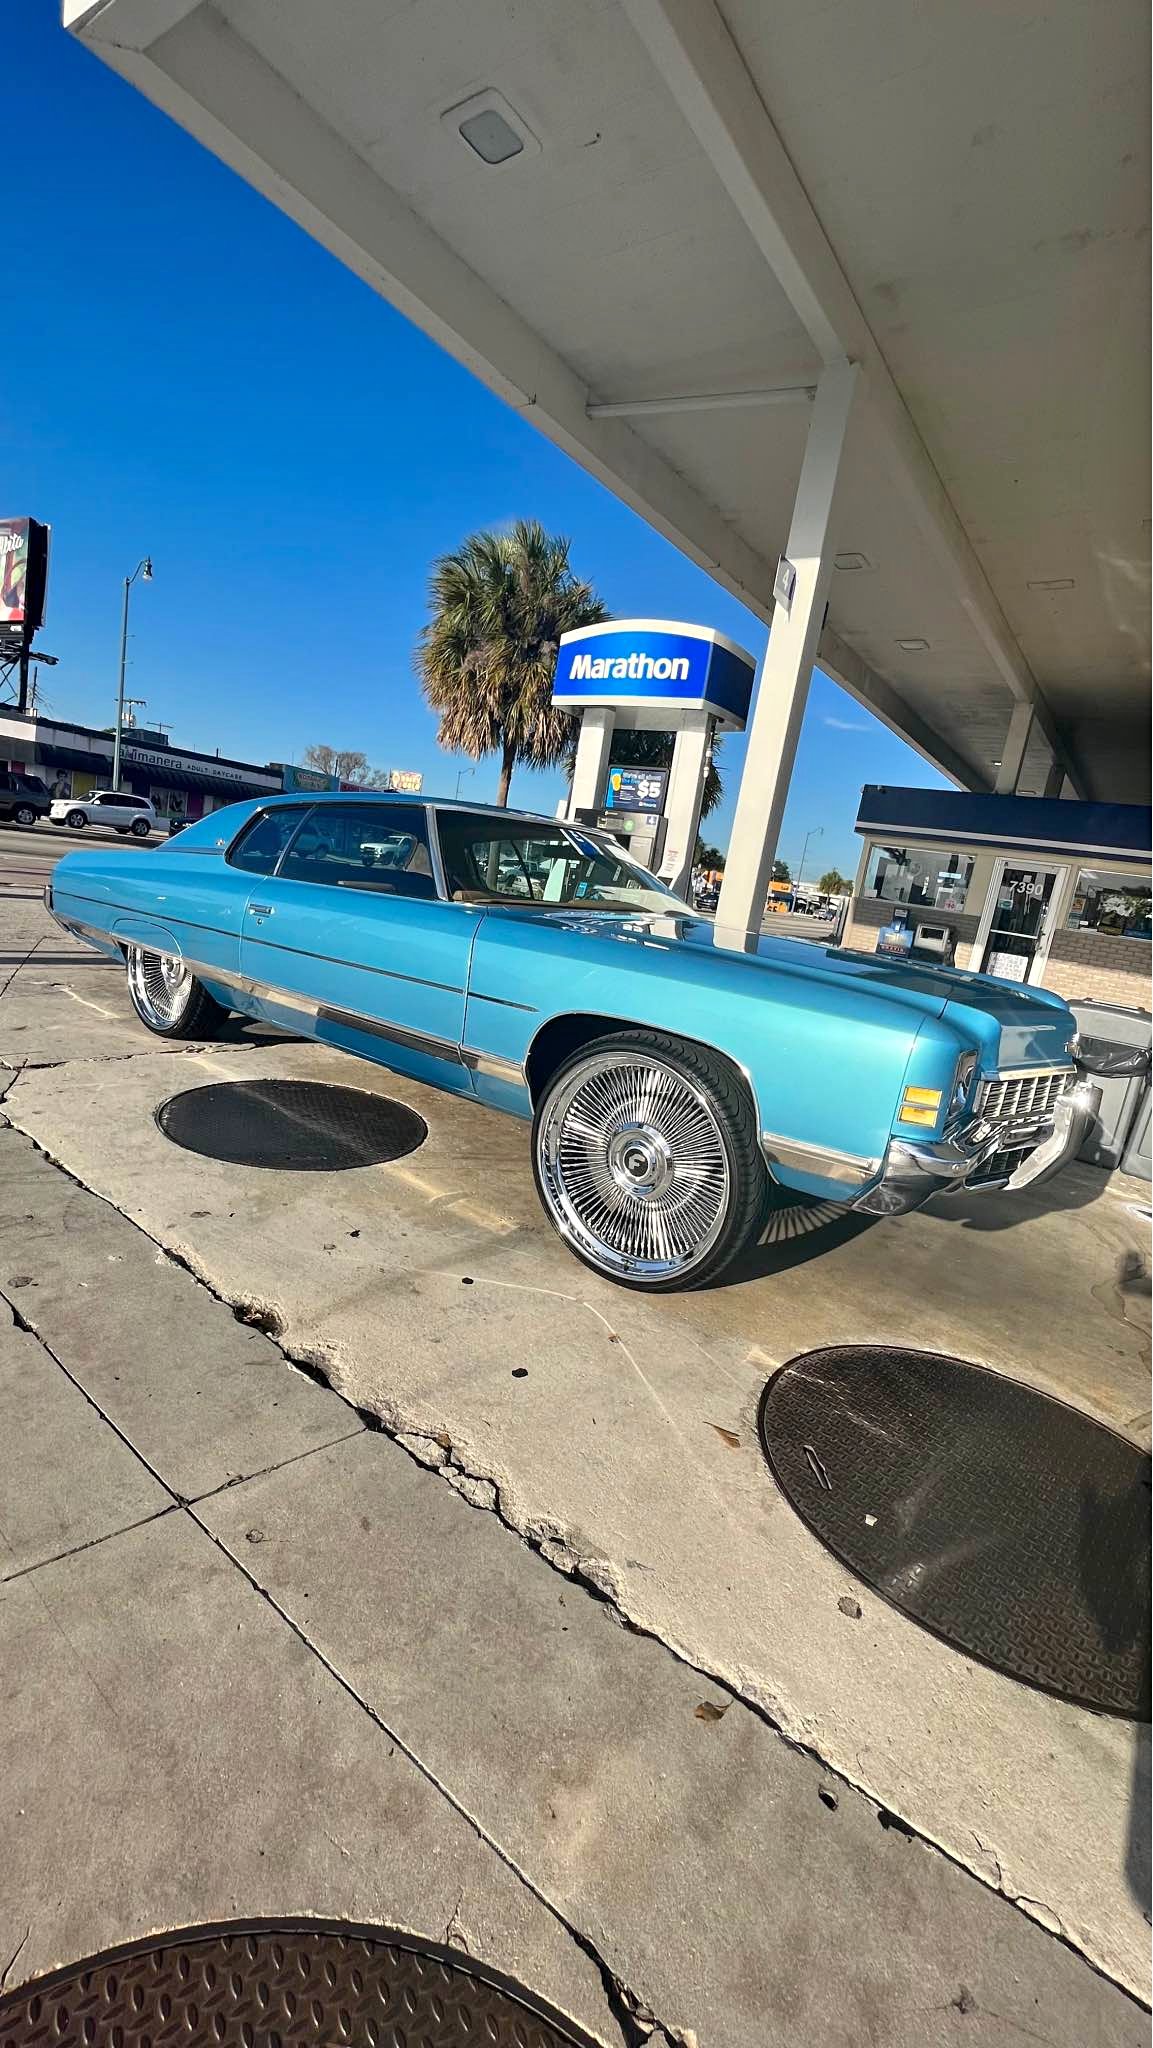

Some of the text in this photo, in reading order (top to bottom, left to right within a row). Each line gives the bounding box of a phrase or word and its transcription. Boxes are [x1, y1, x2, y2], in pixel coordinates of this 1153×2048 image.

[782, 569, 790, 591] 4
[569, 652, 690, 681] Marathon
[637, 780, 661, 800] $5
[1009, 880, 1044, 896] 7390
